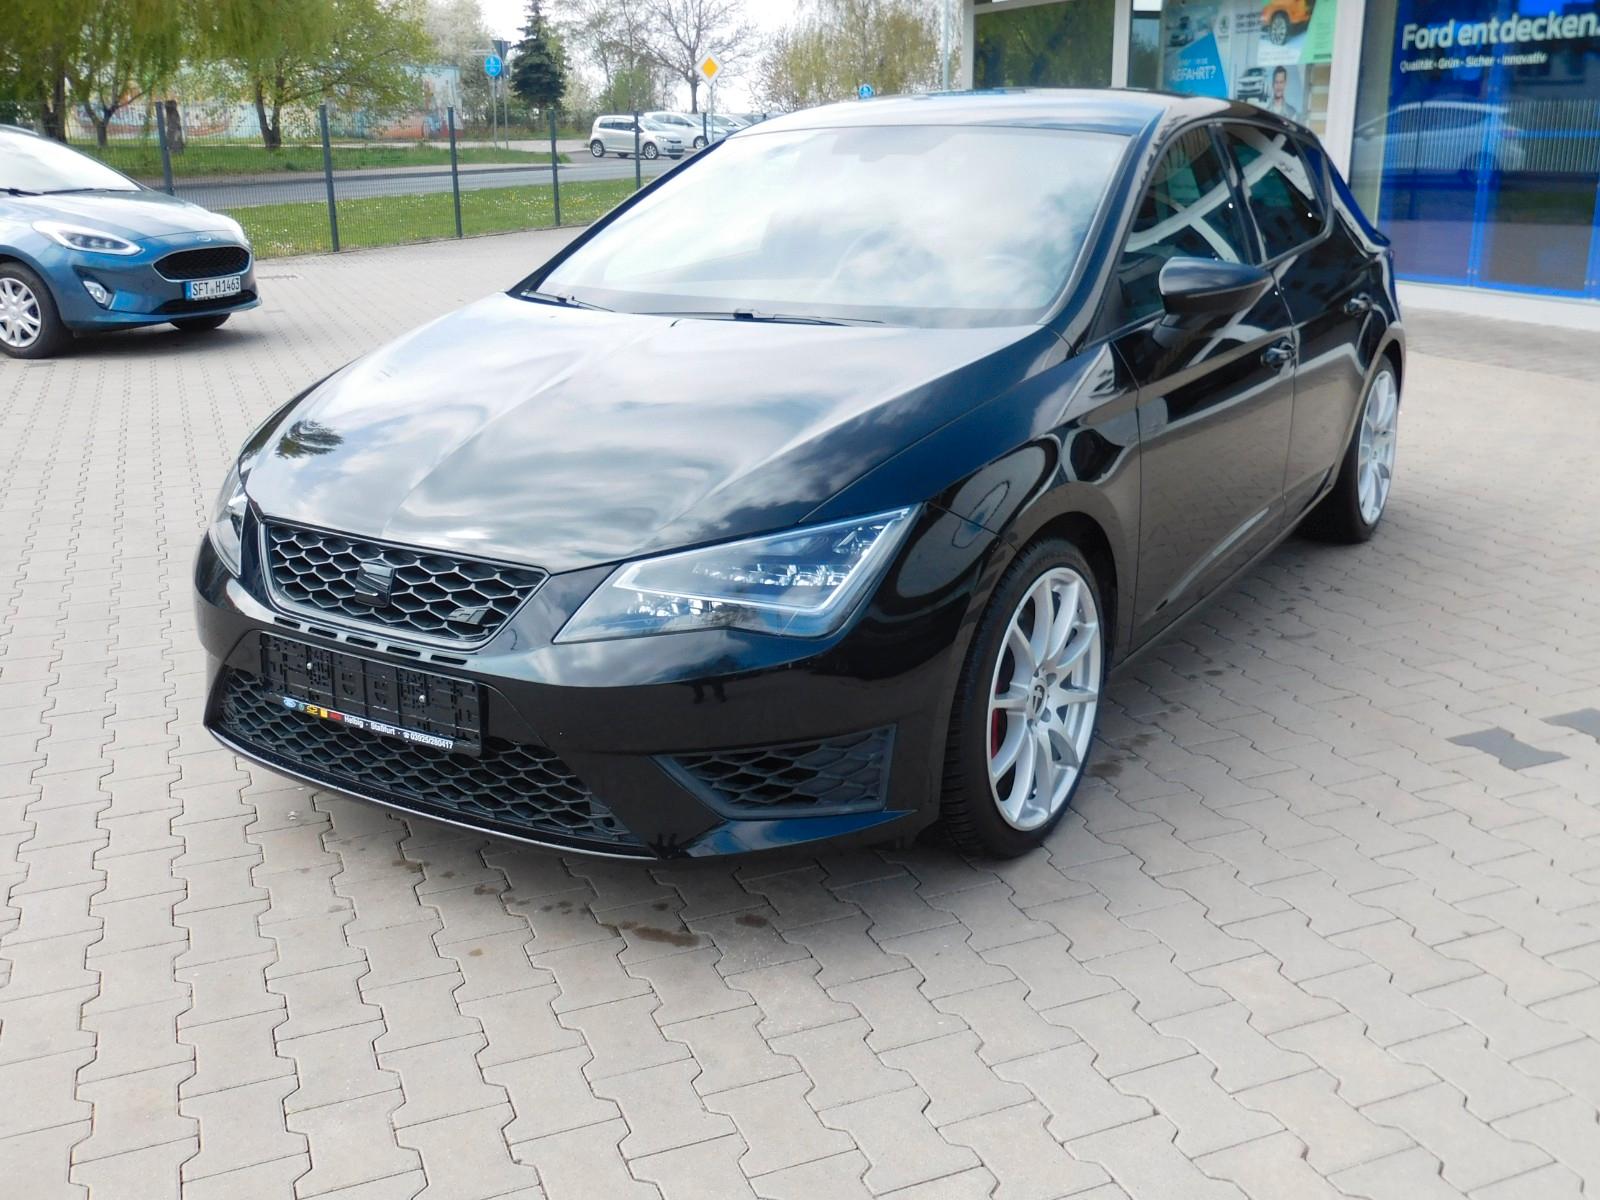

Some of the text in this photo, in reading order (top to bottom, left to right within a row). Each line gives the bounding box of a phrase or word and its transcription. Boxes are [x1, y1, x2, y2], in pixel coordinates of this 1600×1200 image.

[1402, 19, 1454, 50] Ford
[1465, 54, 1495, 68] Sicher
[192, 282, 208, 296] SFT
